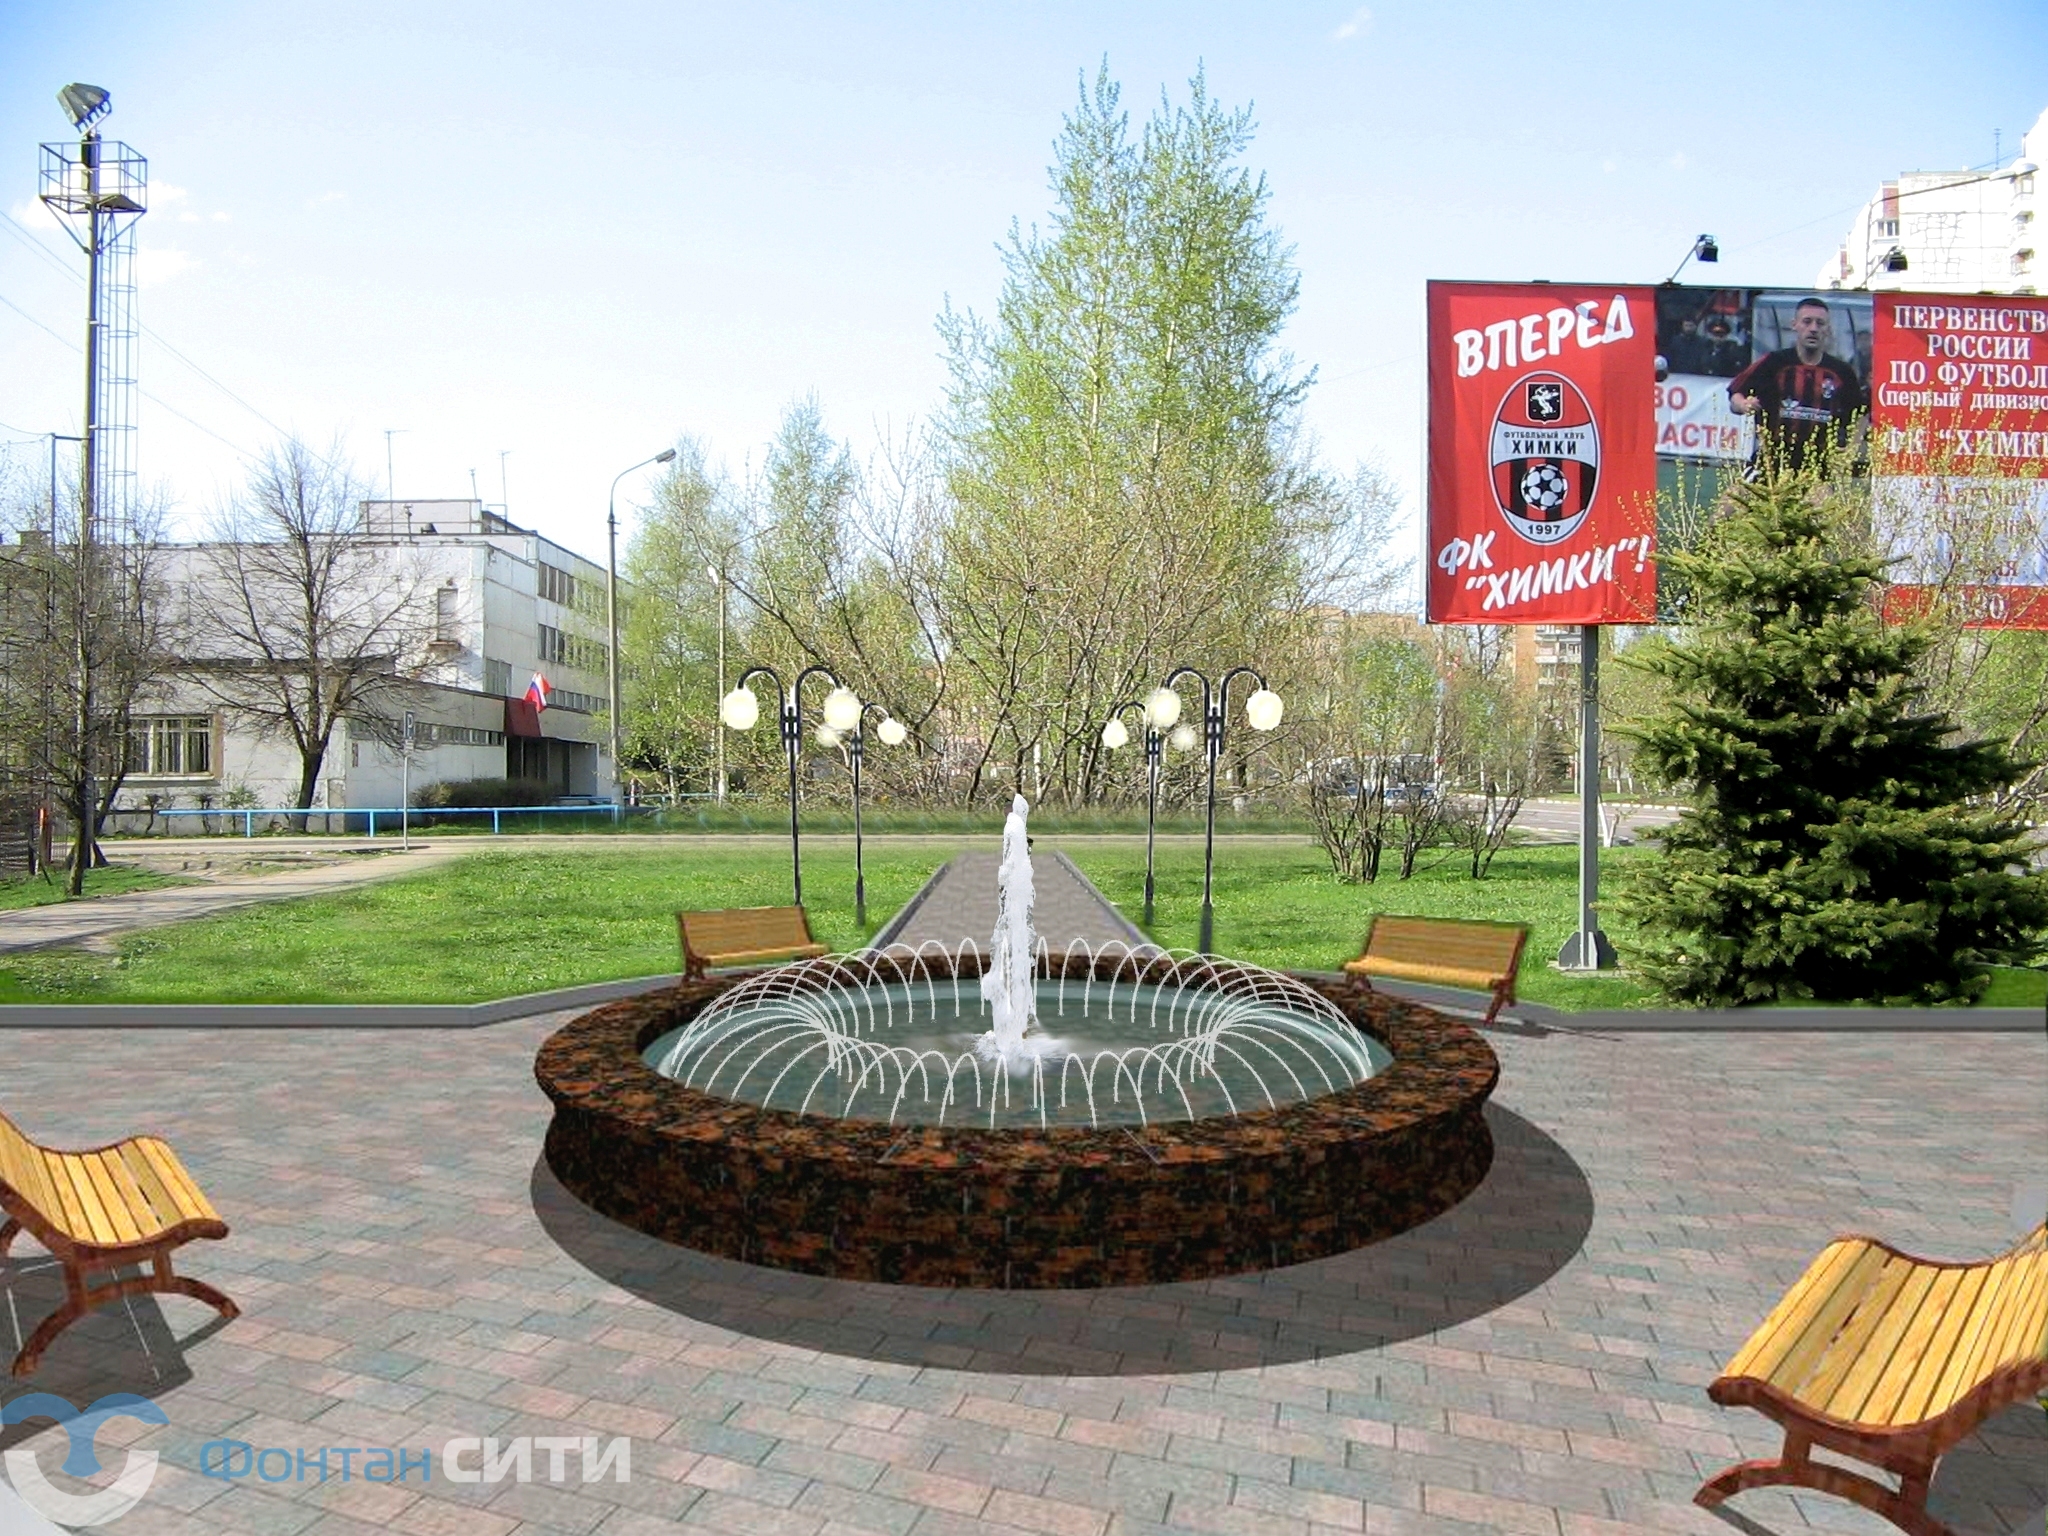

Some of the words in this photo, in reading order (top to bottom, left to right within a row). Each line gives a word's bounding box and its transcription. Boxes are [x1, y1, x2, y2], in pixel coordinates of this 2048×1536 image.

[1893, 305, 2048, 333] ПЕРВЕНСТВ
[1453, 294, 1634, 378] ВПЕРЕД
[1926, 334, 2031, 360] РОССИИ
[1889, 360, 1926, 385] ПО
[1503, 431, 1559, 439] ФУТБОЛЬНЫЙ
[1564, 431, 1585, 440] КЛУБ
[1512, 440, 1577, 455] ХИМКИ
[1528, 525, 1561, 535] 1997
[1437, 530, 1496, 576] ФК
